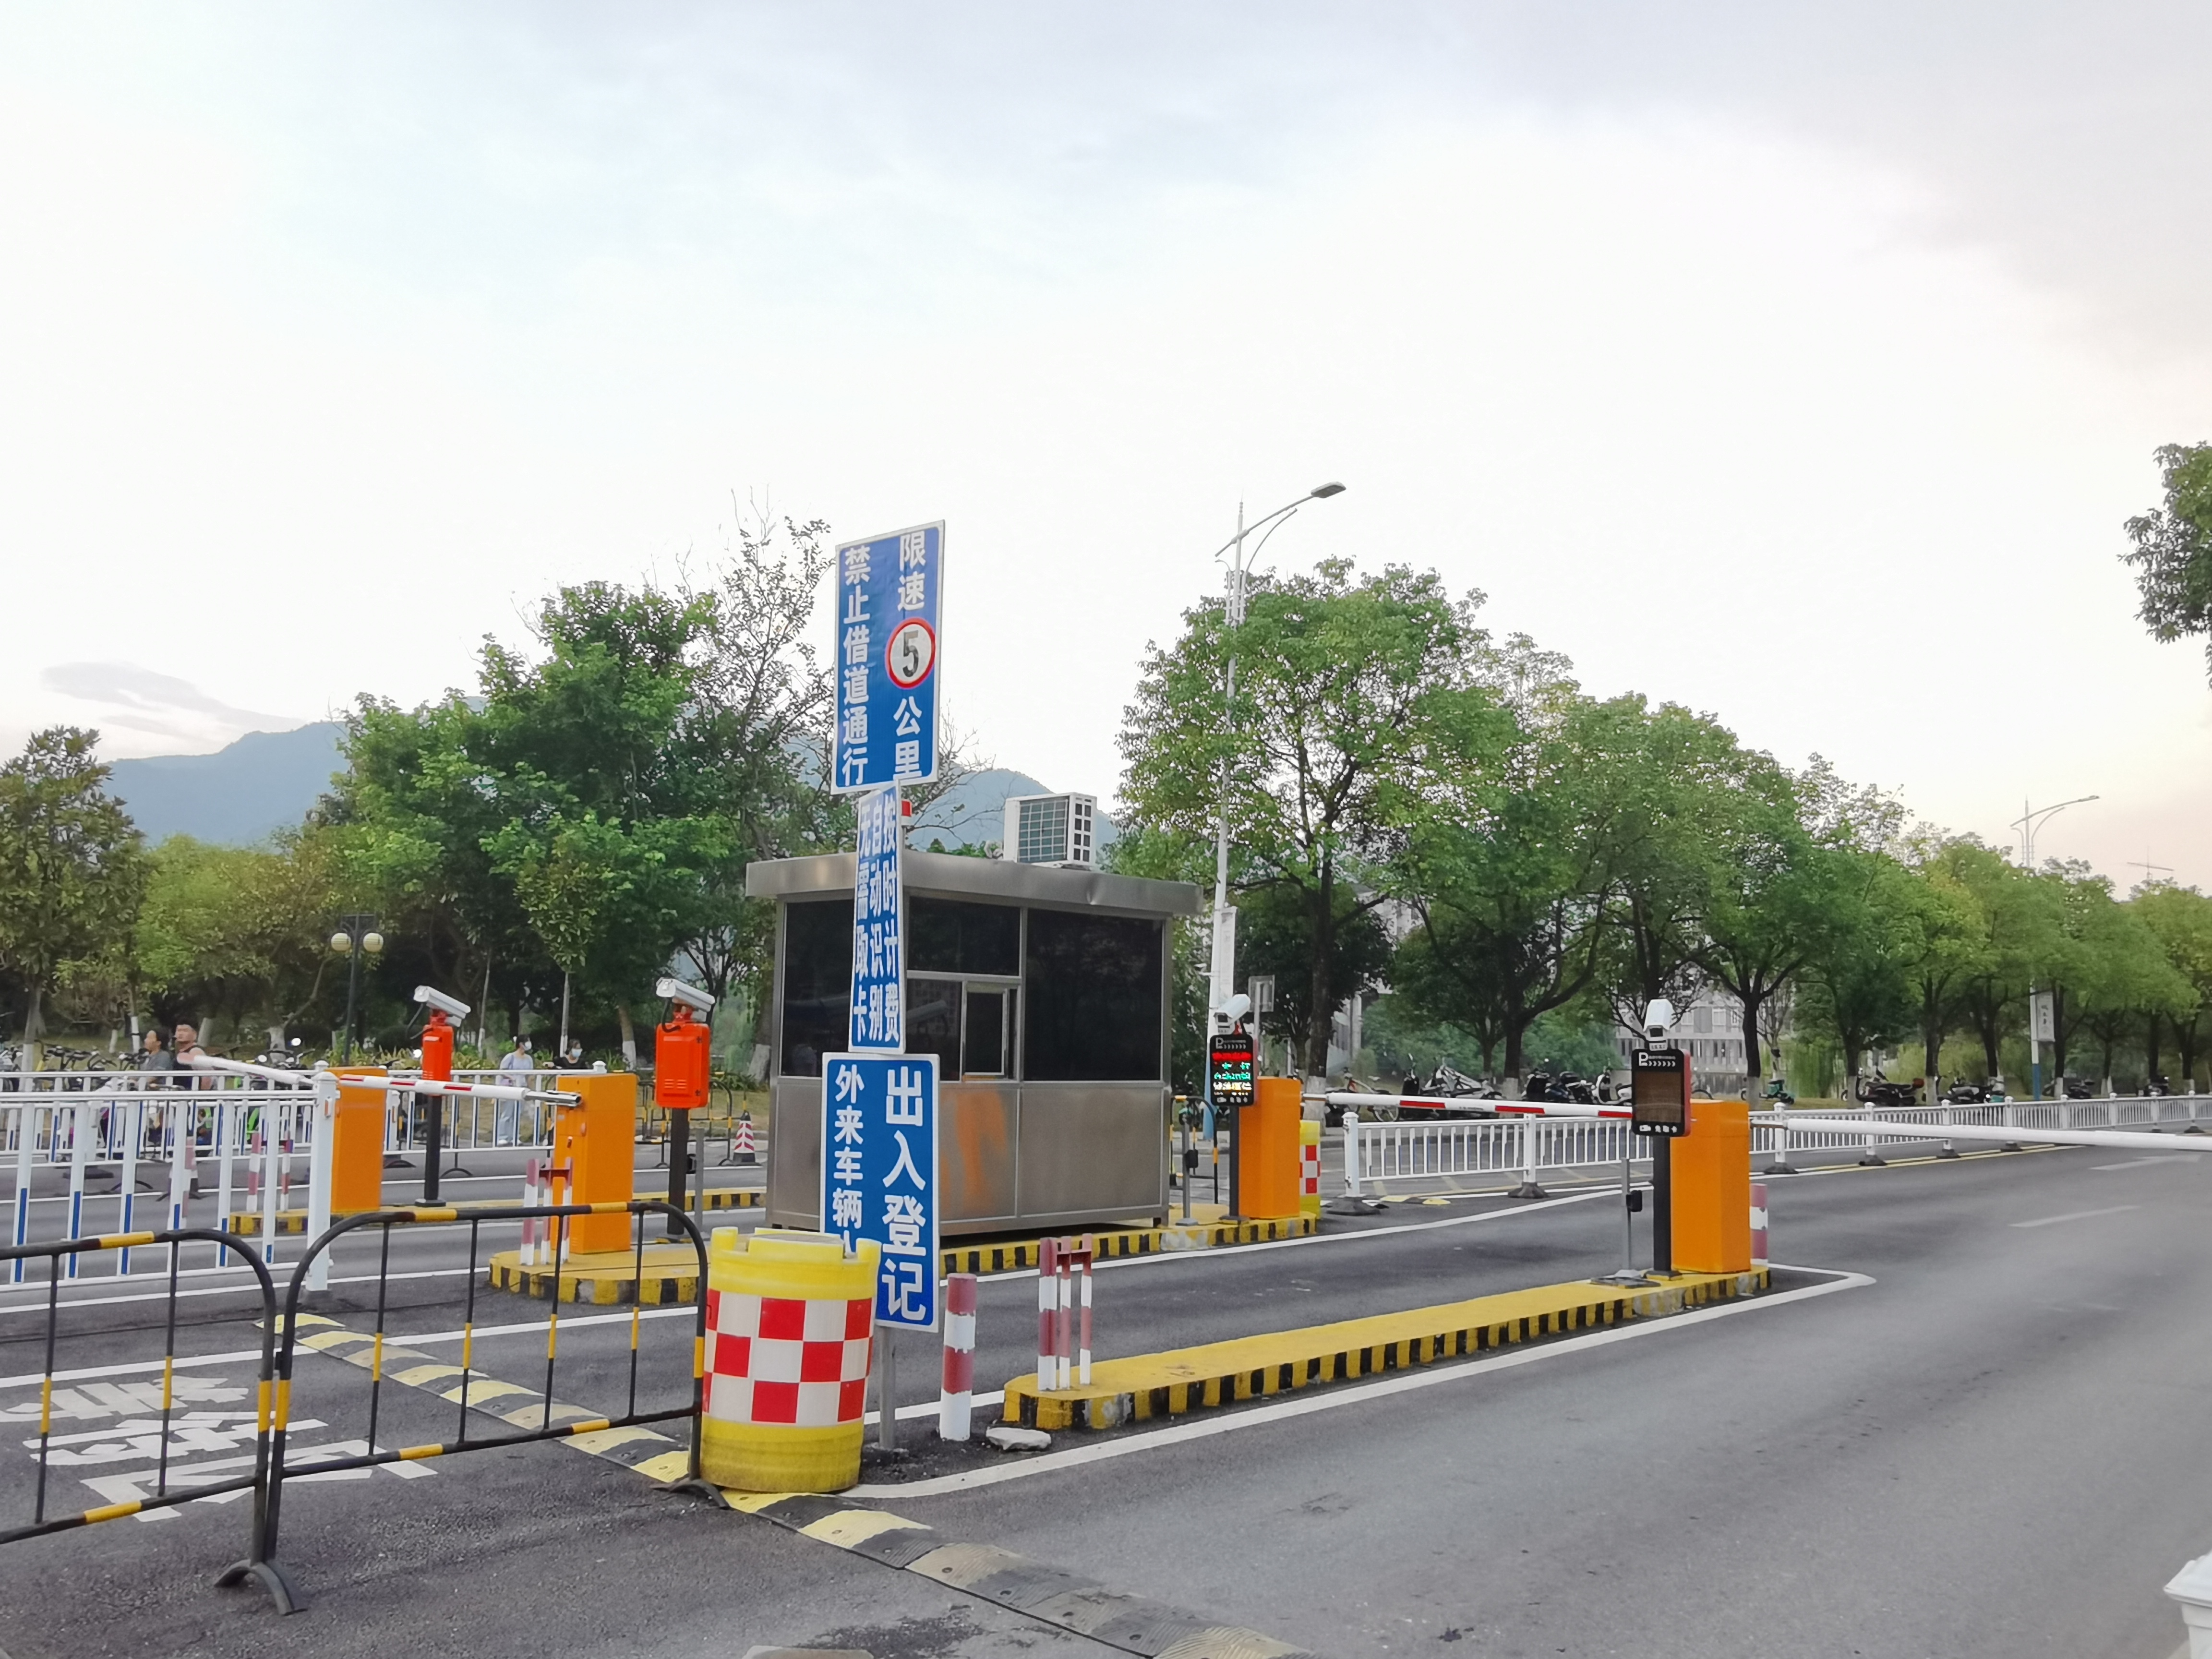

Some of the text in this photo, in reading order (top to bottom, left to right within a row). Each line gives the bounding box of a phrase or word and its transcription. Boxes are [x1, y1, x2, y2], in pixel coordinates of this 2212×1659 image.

[842, 546, 871, 786] 禁止借道通行
[854, 804, 869, 1042] 无需取卡
[869, 799, 883, 1042] 自动识别
[882, 793, 899, 1042] 按时计费
[832, 1064, 865, 1253] 外来车辆
[882, 1066, 926, 1321] 出入登记
